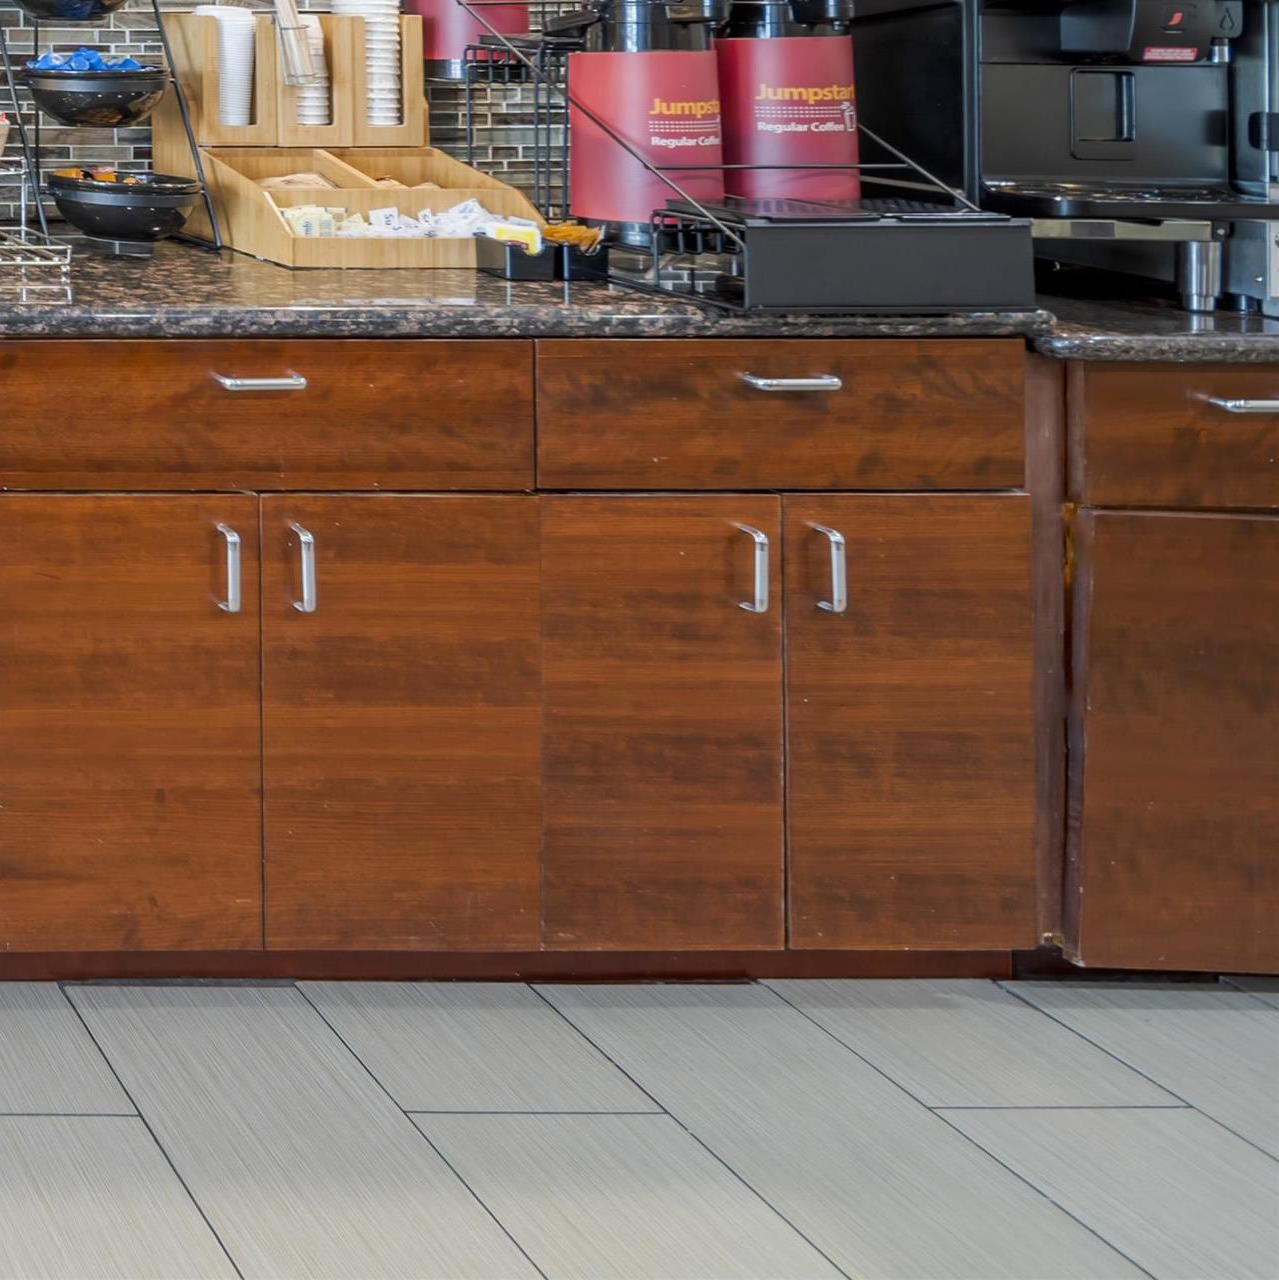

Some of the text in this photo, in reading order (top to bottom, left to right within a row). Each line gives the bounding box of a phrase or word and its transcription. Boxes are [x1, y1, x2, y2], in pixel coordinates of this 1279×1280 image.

[757, 122, 844, 134] Regular Coffee
[651, 136, 697, 148] Regular
